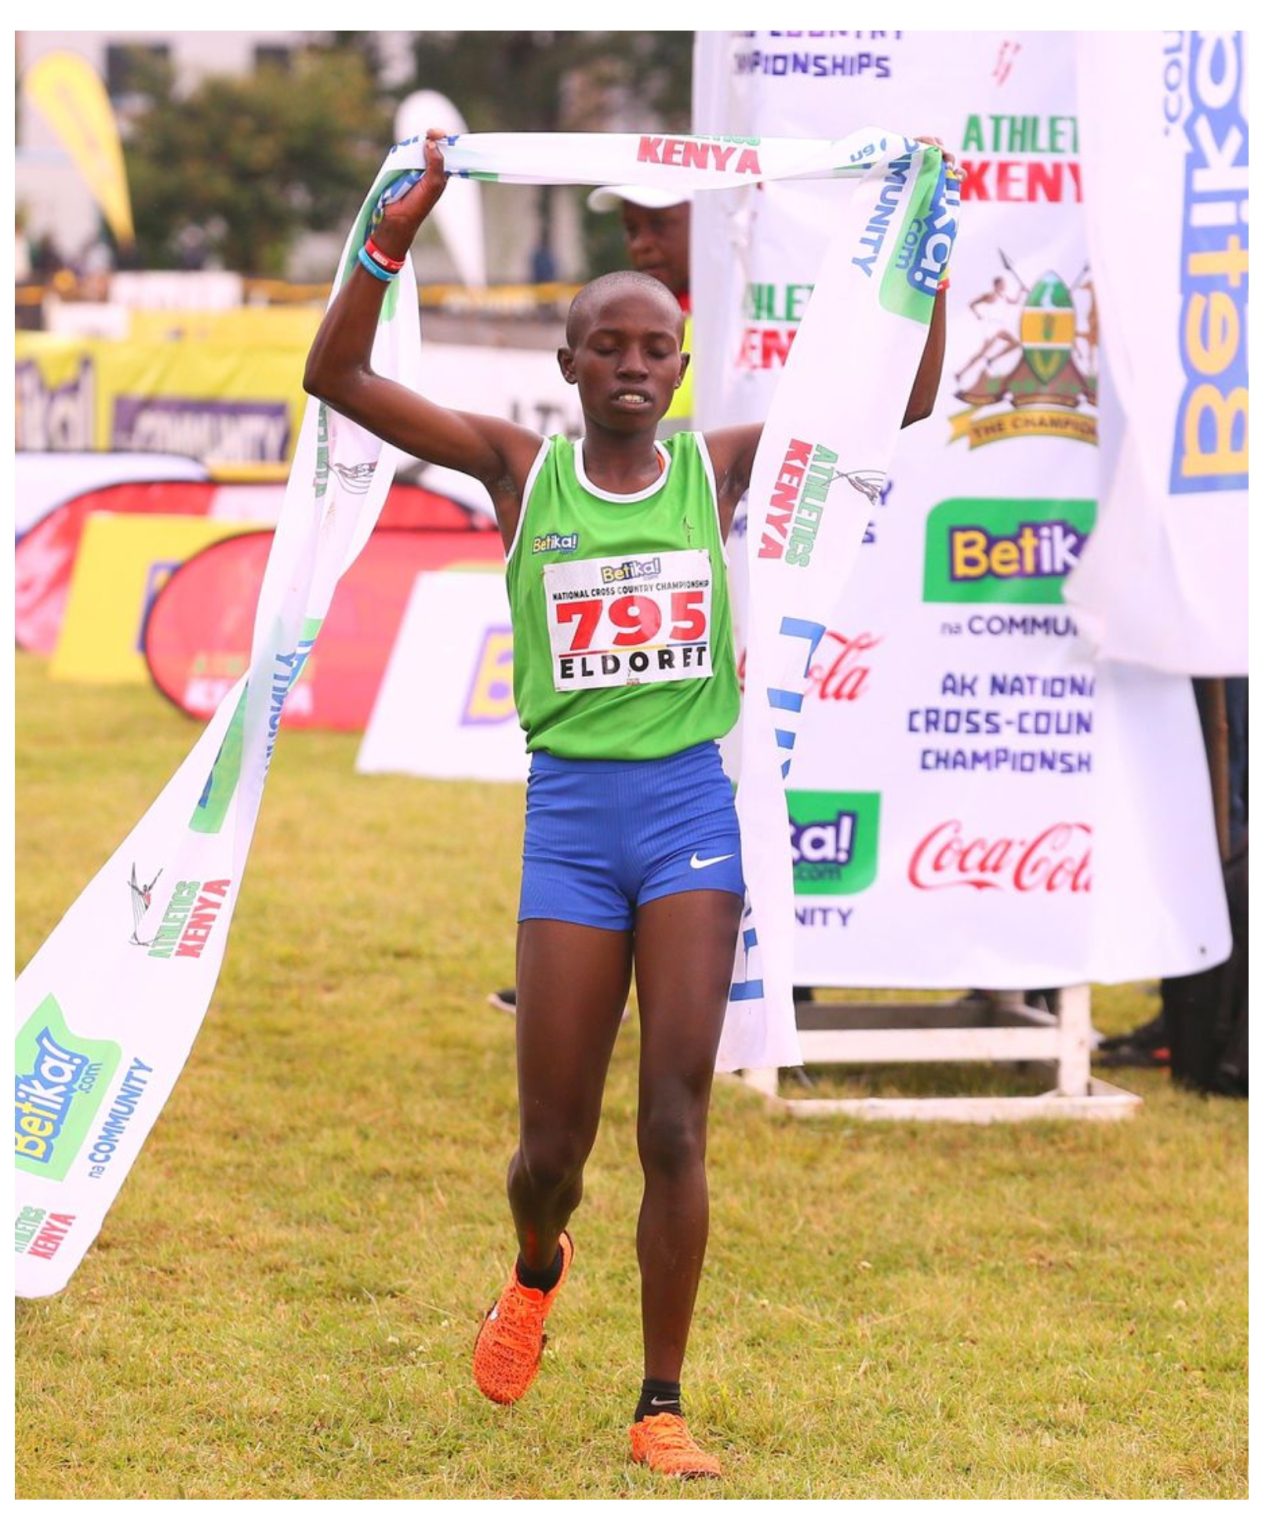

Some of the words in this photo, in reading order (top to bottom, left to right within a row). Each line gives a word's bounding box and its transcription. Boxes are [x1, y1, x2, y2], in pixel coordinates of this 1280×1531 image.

[637, 136, 762, 174] KENYA
[757, 438, 814, 560] KENYA
[785, 443, 840, 568] ATHLETICS
[532, 532, 578, 554] Betika!
[552, 590, 590, 600] NATIONAL
[591, 586, 616, 598] CROSS
[617, 583, 655, 595] COUNTRY
[656, 579, 710, 592] CHAMPIONSHIP
[601, 557, 661, 584] Betika!
[555, 590, 707, 651] 795
[940, 621, 962, 635] na
[560, 646, 707, 680] ELDORET
[942, 672, 978, 697] AK
[908, 708, 1093, 736] CROSS-COUN
[148, 880, 201, 959] ATHLETICS
[174, 878, 232, 959] KENYA
[15, 1031, 87, 1161] Betika!
[88, 1056, 153, 1163] COMMUNITY
[27, 1212, 76, 1260] KENYA
